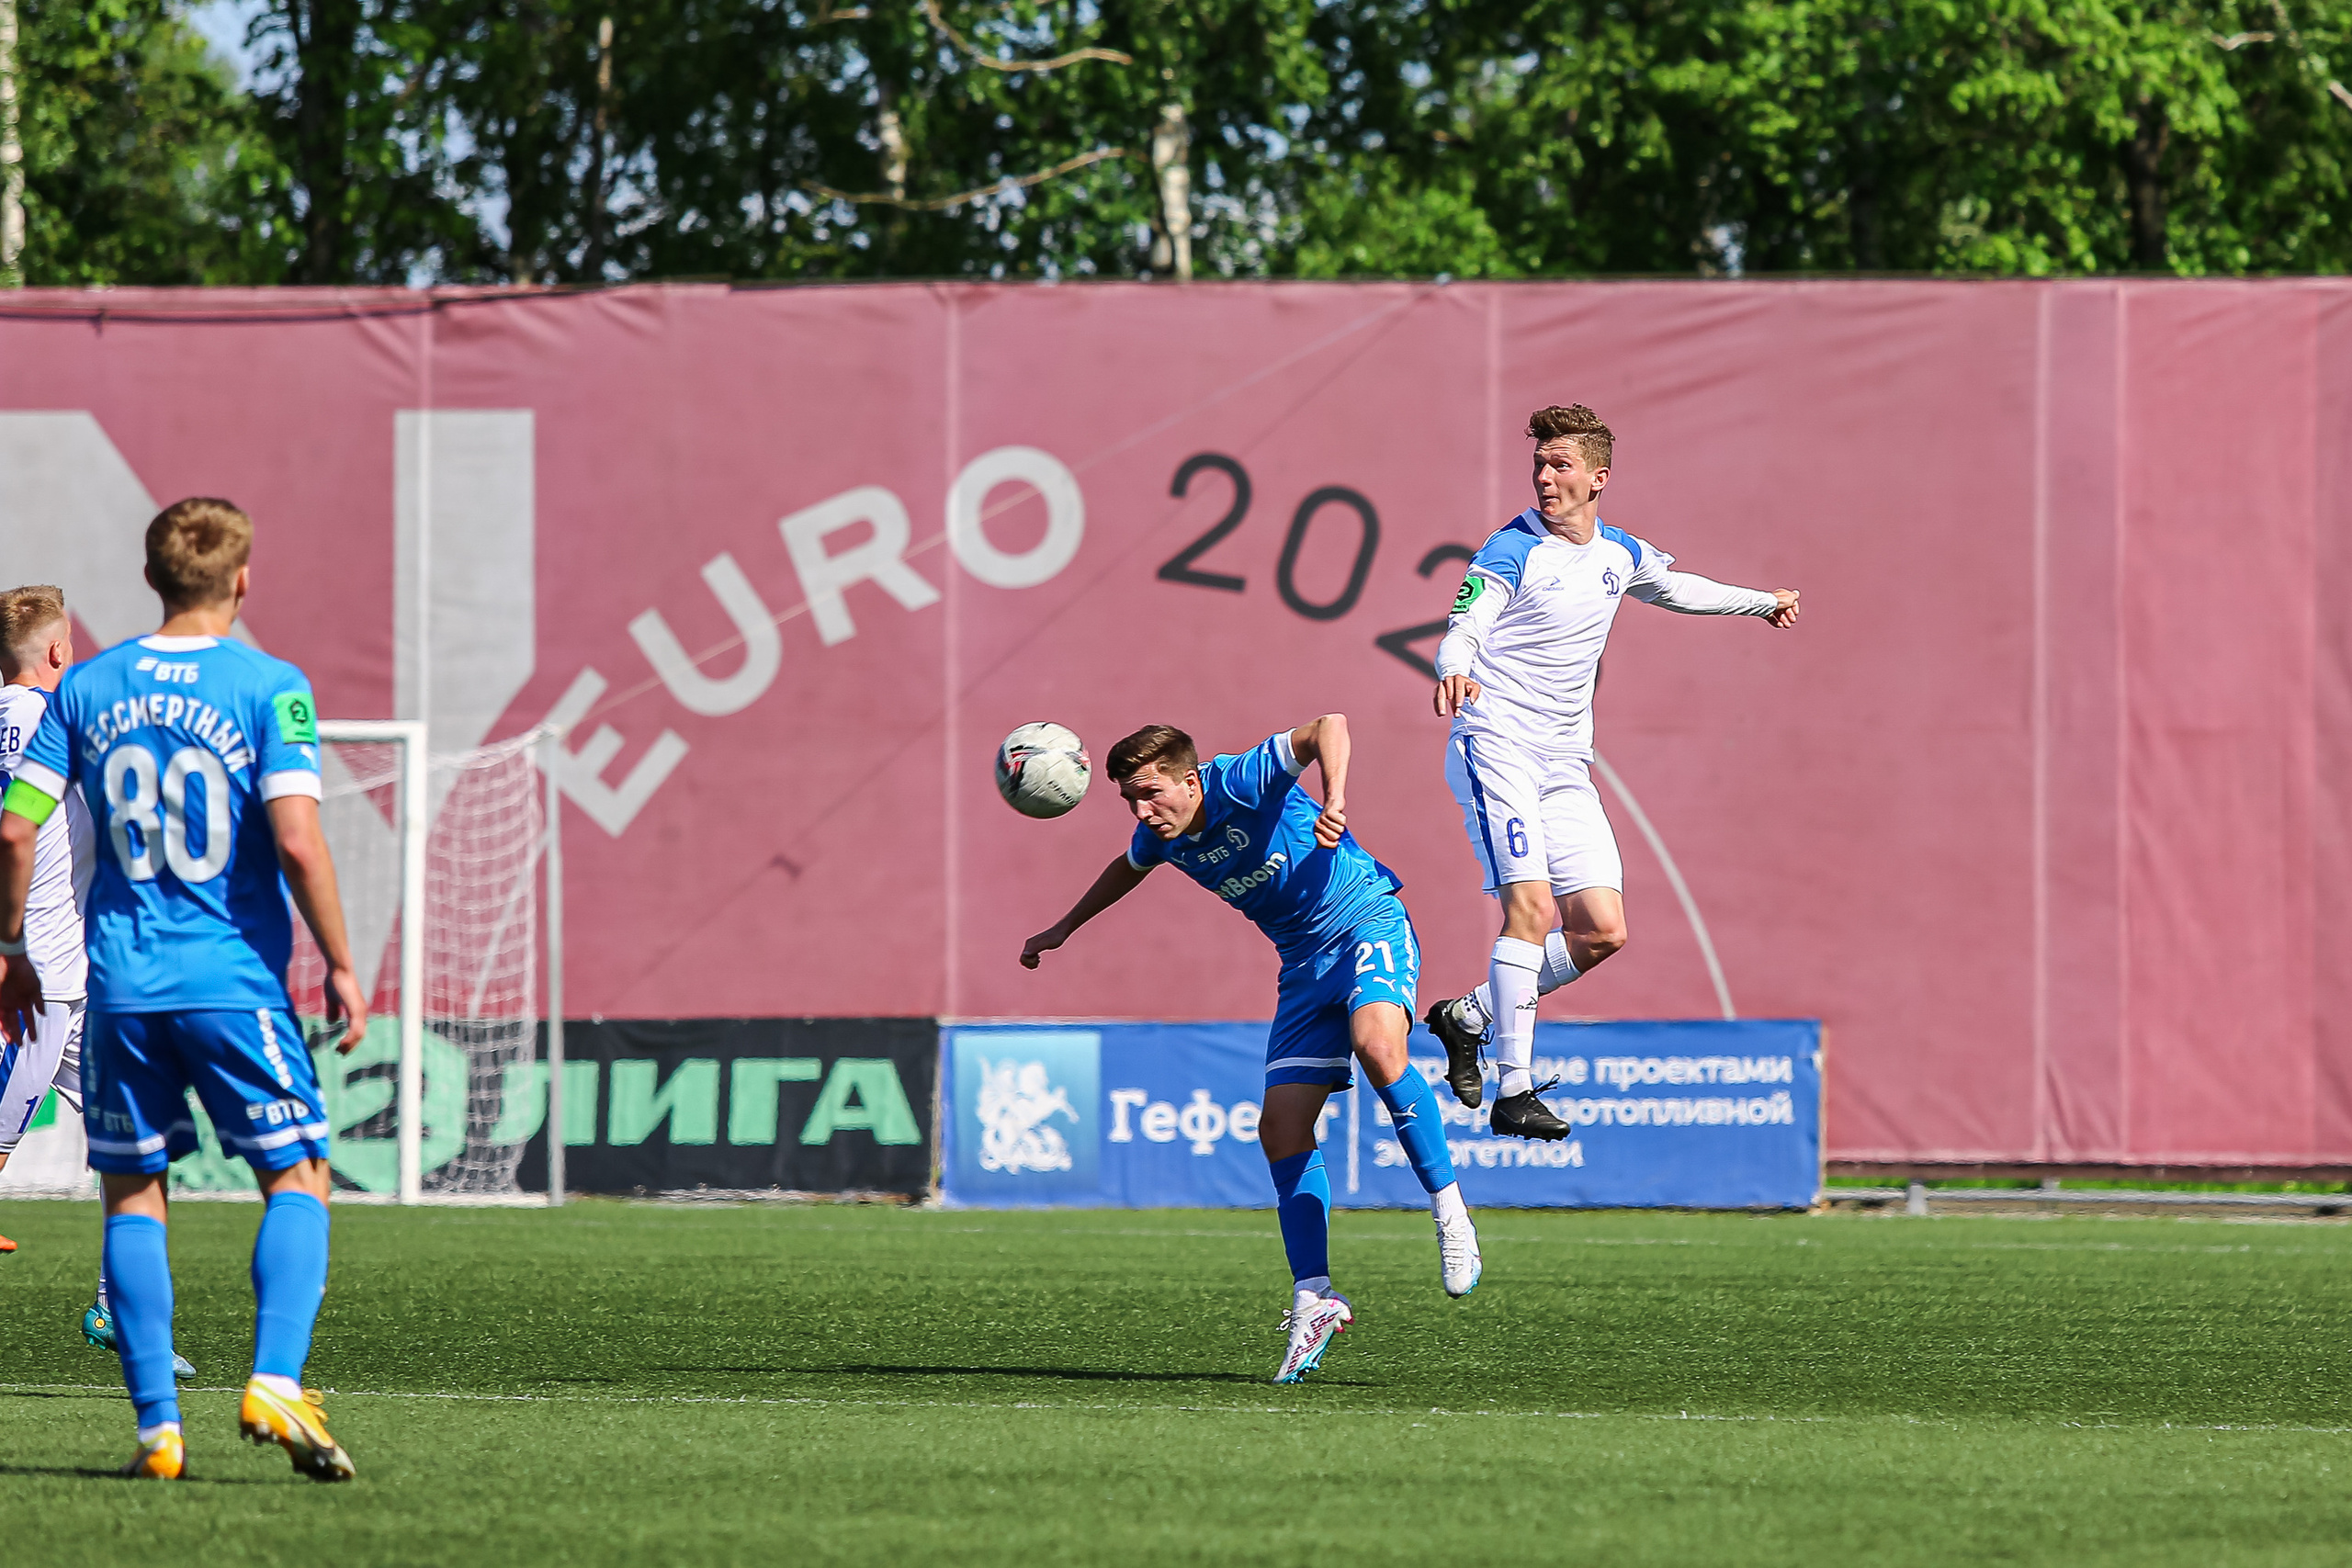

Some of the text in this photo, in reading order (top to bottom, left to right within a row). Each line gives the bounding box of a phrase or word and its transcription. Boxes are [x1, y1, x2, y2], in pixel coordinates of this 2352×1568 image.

[534, 446, 1476, 839] EURO 202
[154, 660, 200, 684] ВТБ
[104, 743, 231, 884] 80
[1206, 845, 1230, 864] ВТБ
[1506, 817, 1530, 859] 6
[1354, 940, 1396, 976] 21
[1594, 1055, 1793, 1091] проектами
[492, 1057, 923, 1146] ЛИГА
[1544, 1089, 1794, 1126] зотопливной
[1108, 1088, 1340, 1156] Гефет
[1374, 1139, 1586, 1168] эгетики
